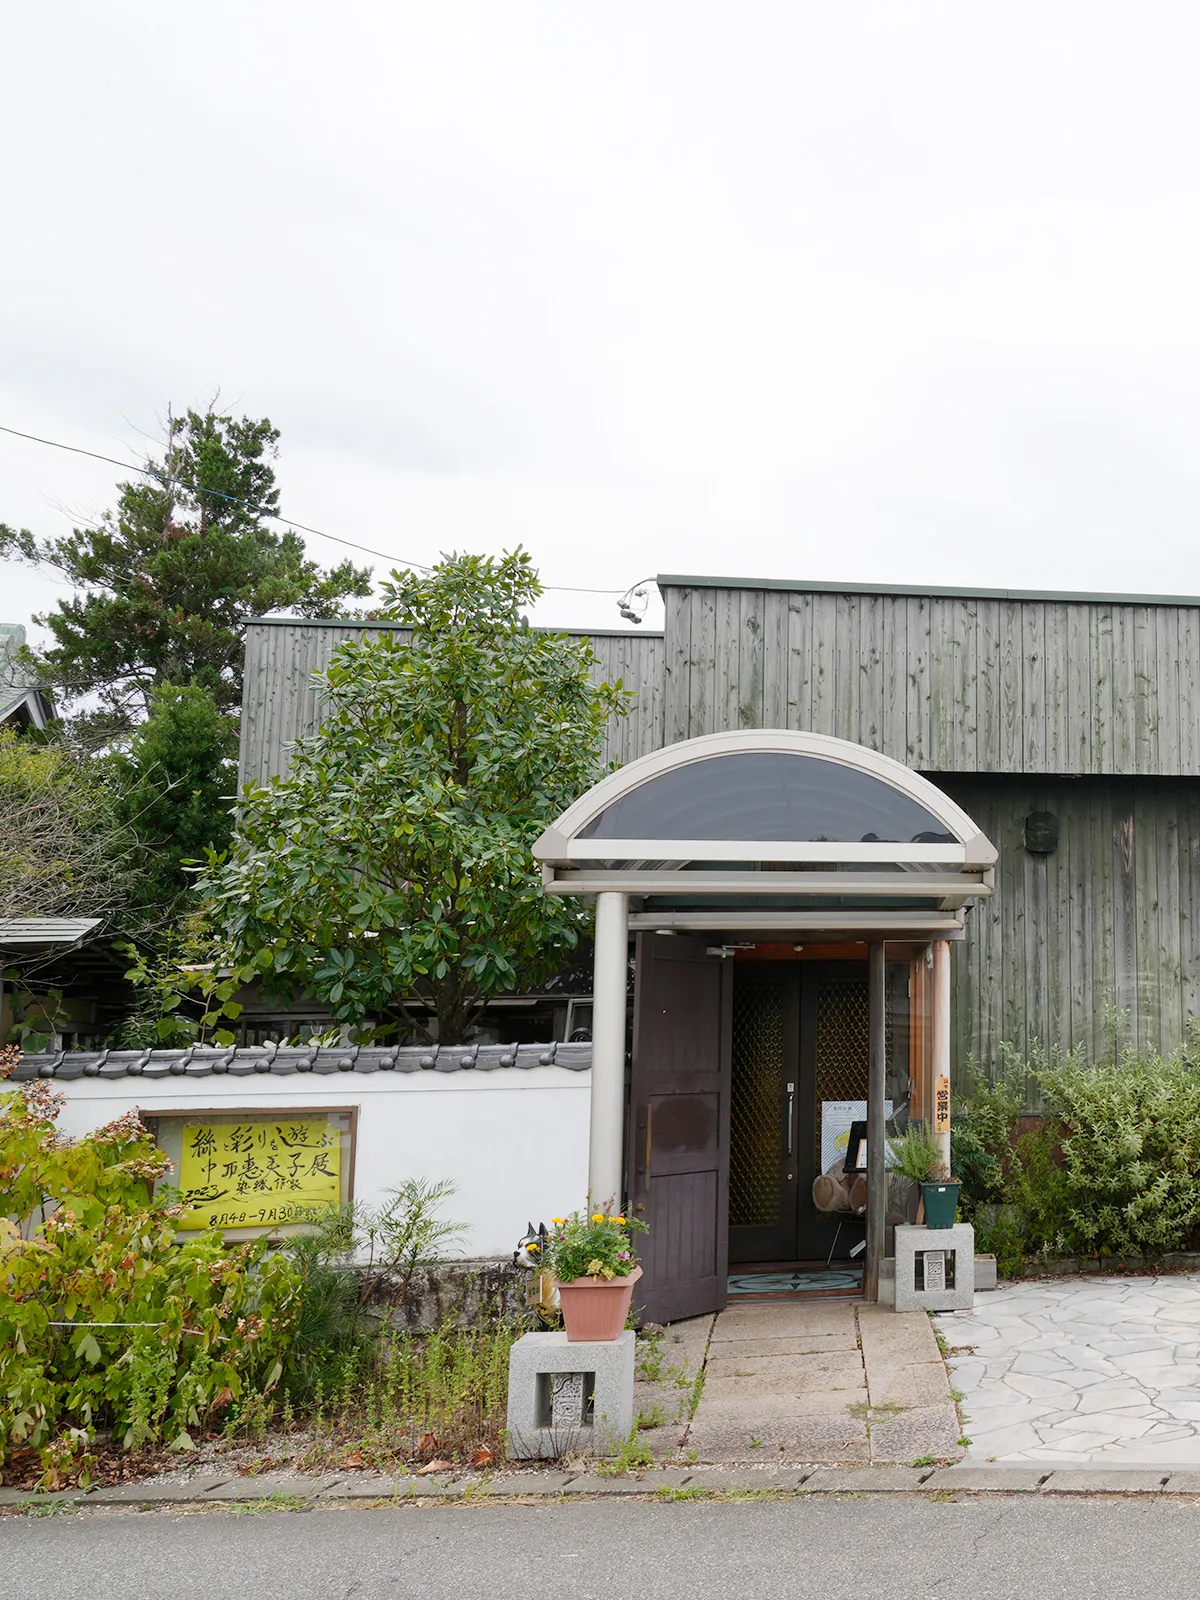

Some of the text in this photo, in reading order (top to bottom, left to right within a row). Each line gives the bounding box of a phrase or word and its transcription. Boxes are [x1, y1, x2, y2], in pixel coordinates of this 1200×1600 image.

[937, 1090, 948, 1122] 営業中
[185, 1185, 219, 1198] 2023
